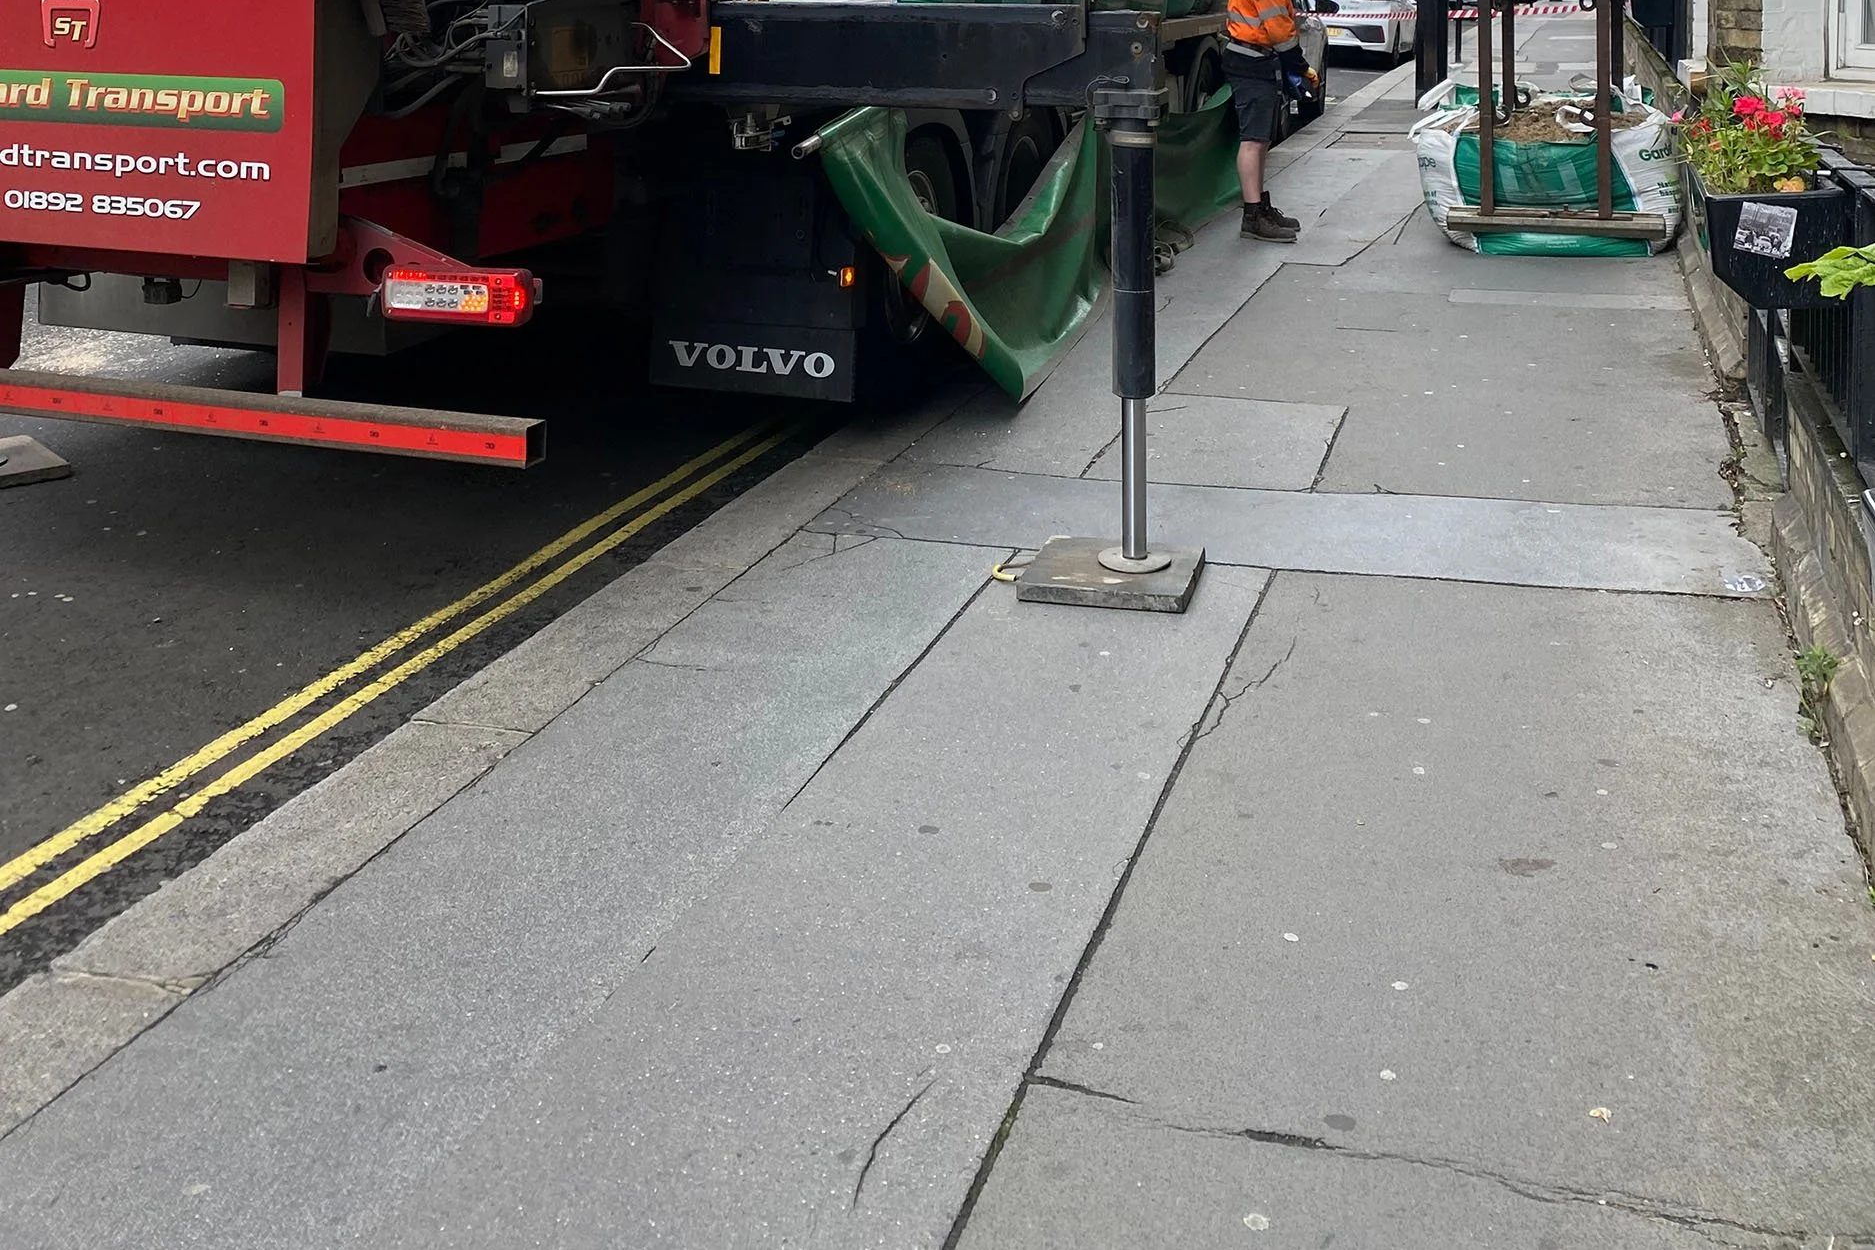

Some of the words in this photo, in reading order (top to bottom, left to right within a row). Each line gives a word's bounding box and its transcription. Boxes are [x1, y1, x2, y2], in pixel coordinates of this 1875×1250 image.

[54, 17, 87, 41] ST
[66, 78, 274, 122] Transport
[0, 143, 271, 181] dtransport.com
[3, 189, 84, 213] 01892
[92, 194, 201, 220] 835067
[668, 340, 836, 378] VOLVO
